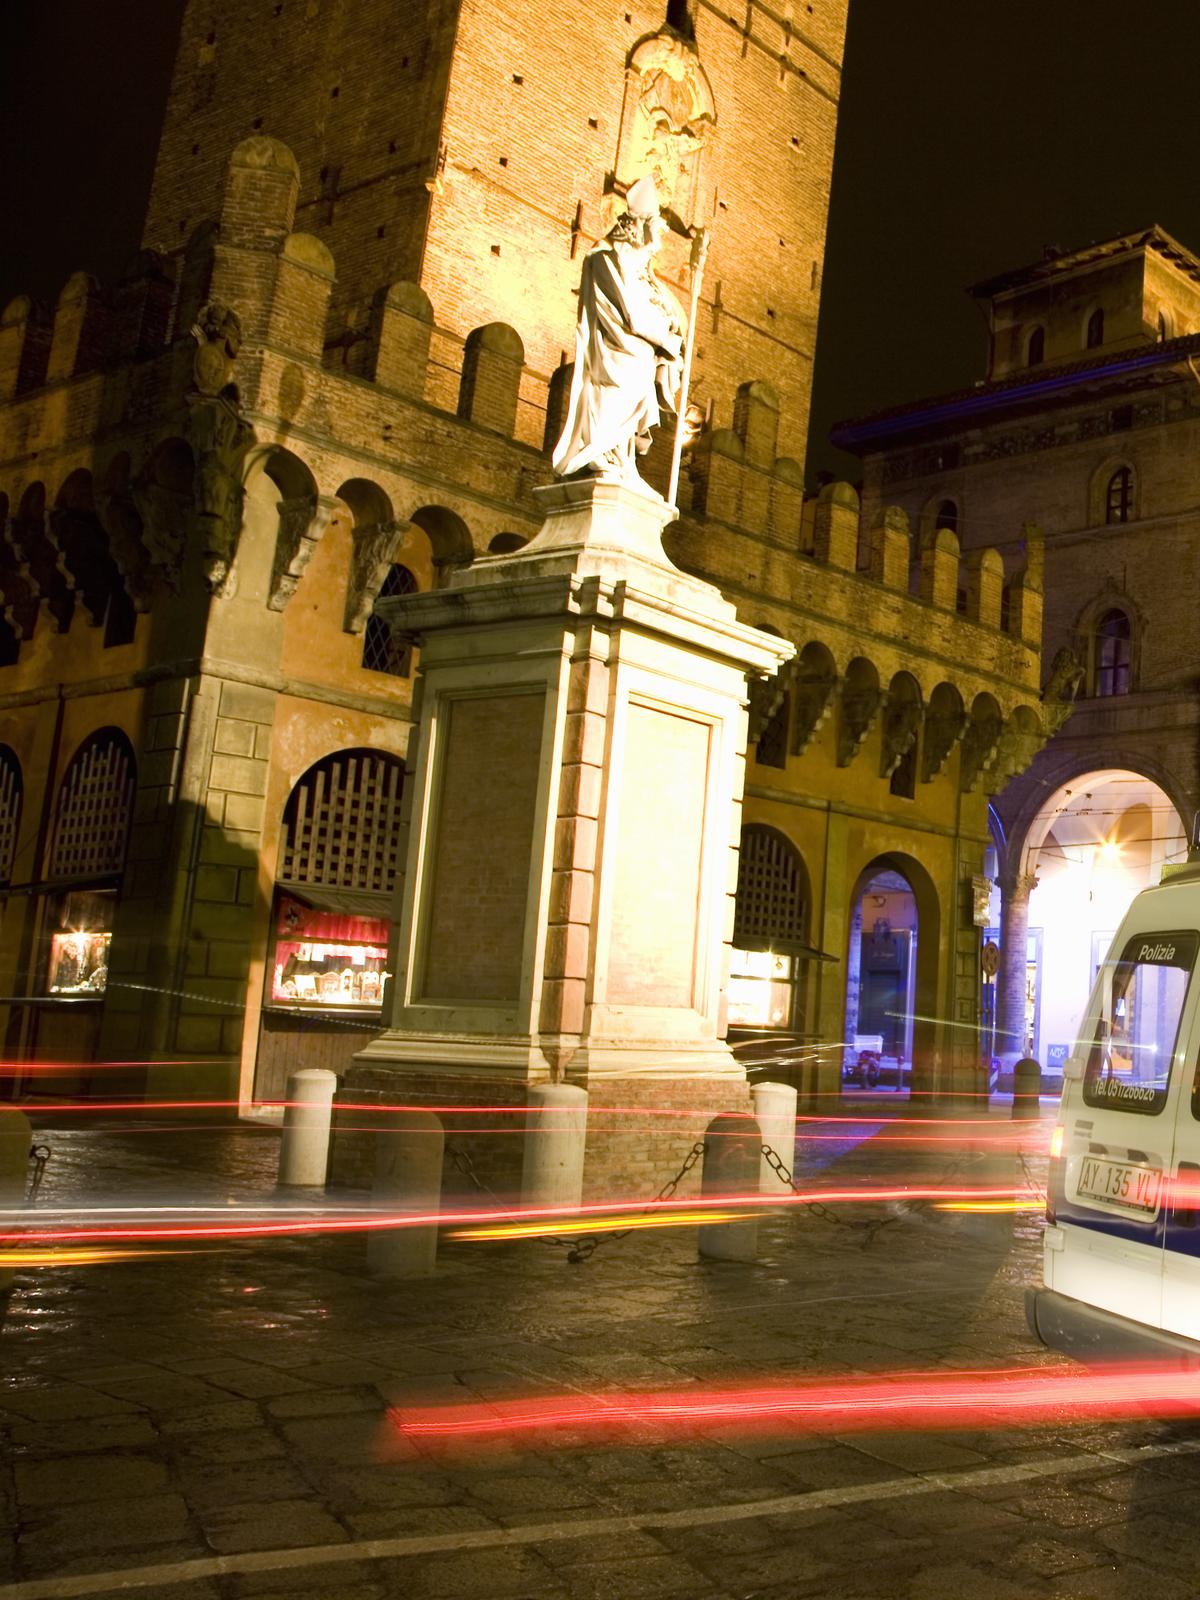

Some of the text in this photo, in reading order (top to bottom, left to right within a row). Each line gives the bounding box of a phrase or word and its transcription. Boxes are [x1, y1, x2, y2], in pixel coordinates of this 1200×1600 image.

[1138, 944, 1176, 961] Polizia
[1096, 1079, 1107, 1096] Tel.
[1081, 1164, 1100, 1190] AY
[1105, 1167, 1132, 1197] 135
